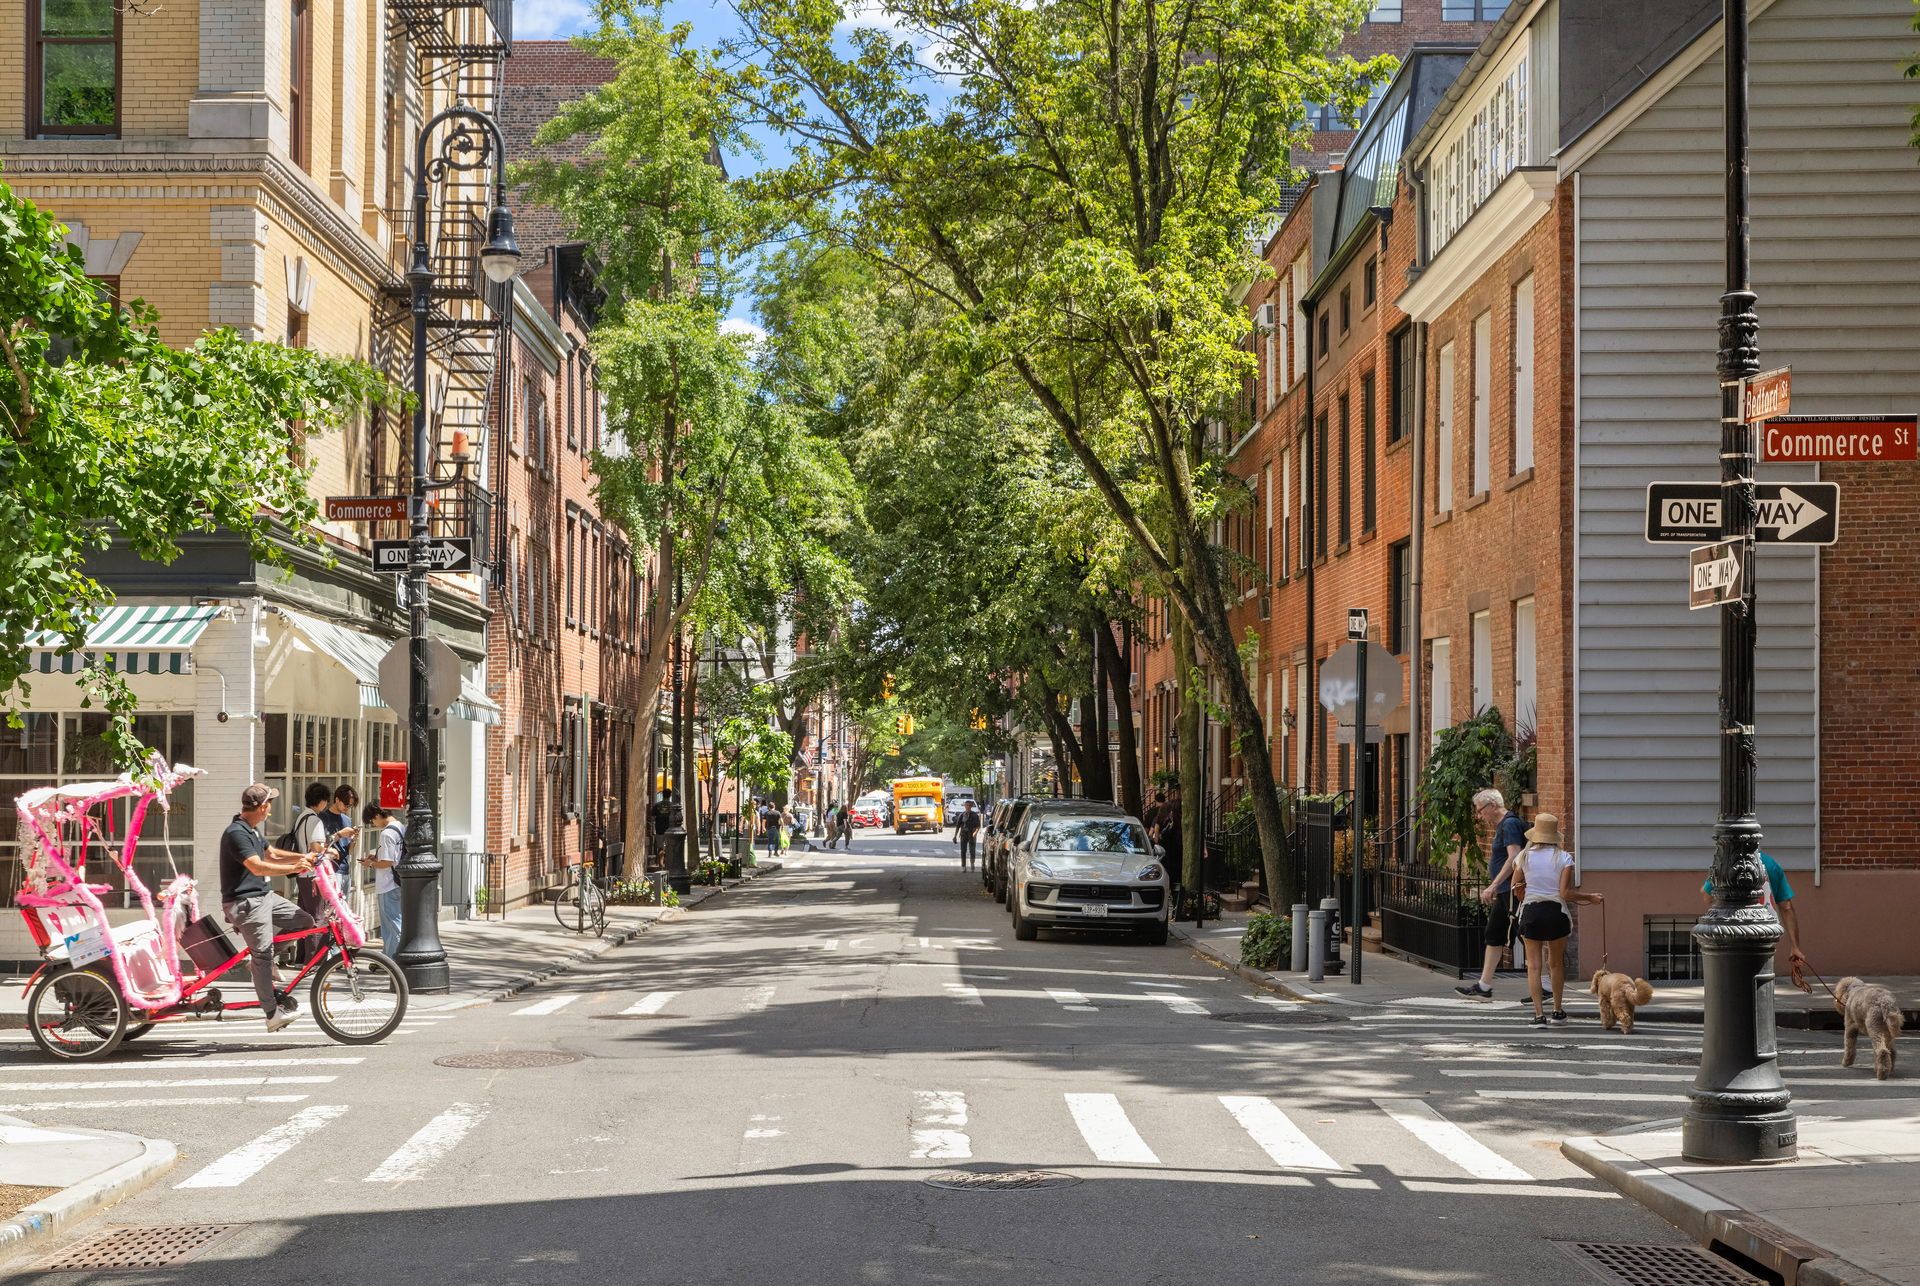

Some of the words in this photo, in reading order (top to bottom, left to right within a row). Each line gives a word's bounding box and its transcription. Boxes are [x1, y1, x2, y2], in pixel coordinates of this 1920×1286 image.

[1746, 383, 1778, 418] Bedford
[1781, 380, 1788, 398] St
[1767, 428, 1883, 456] Commerce
[1894, 427, 1909, 445] St
[329, 503, 392, 519] Commerce
[397, 502, 405, 512] St
[1668, 502, 1717, 524] ONE
[1756, 503, 1805, 524] WAY
[387, 550, 409, 562] ON
[429, 549, 456, 561] WAY
[1697, 564, 1713, 589] ONE
[1718, 559, 1735, 585] WAY
